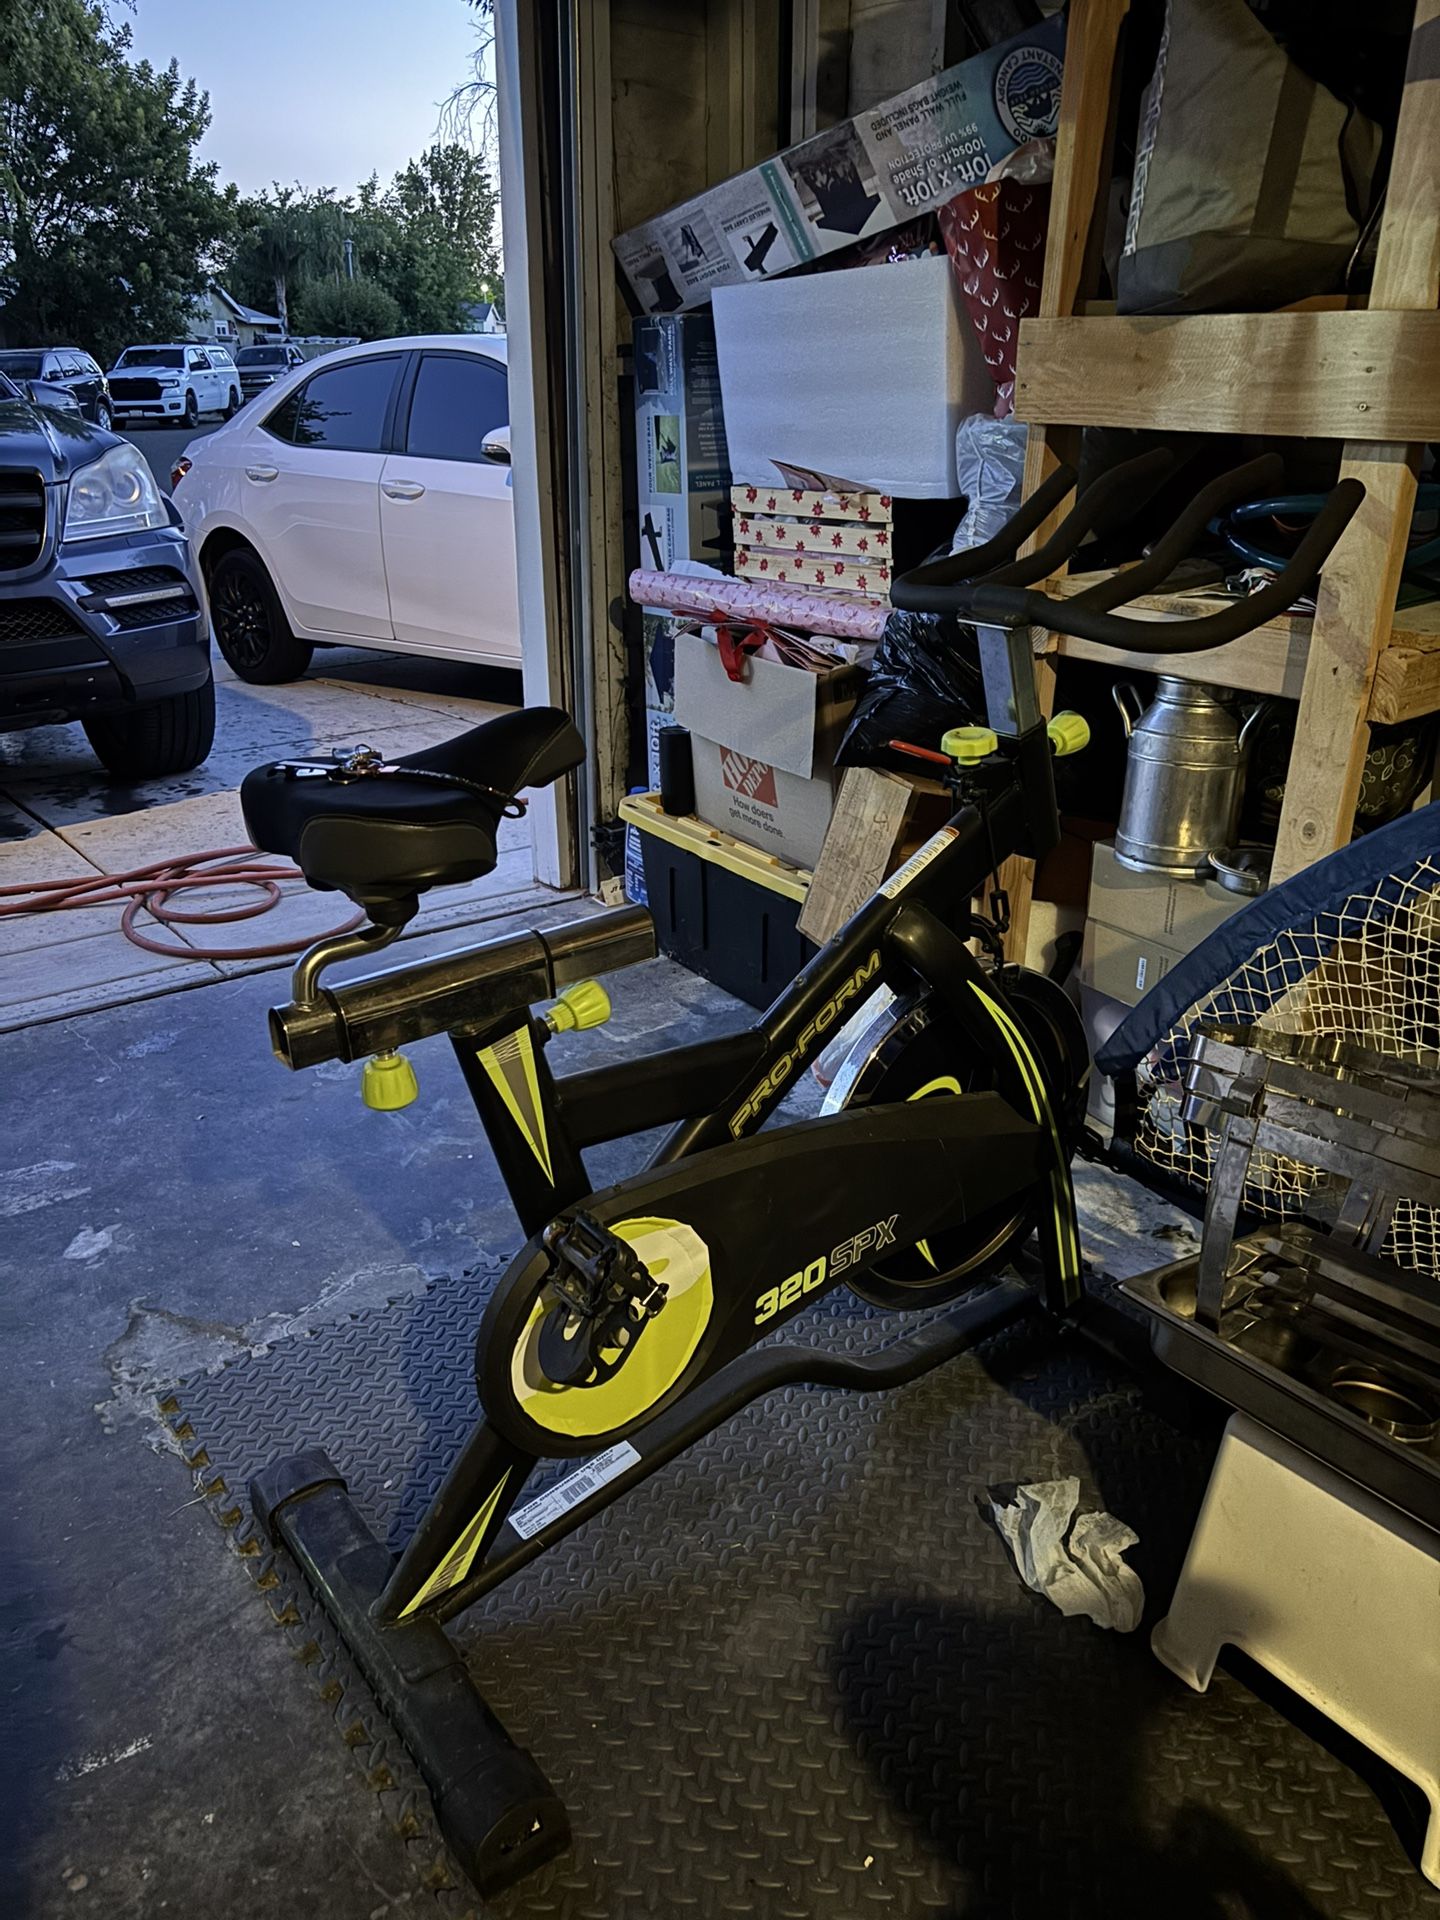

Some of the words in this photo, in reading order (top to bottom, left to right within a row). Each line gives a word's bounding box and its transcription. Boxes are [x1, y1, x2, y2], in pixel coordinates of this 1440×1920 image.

[1019, 49, 1064, 74] NSTANT
[929, 80, 962, 100] WEIGHT
[996, 55, 1018, 104] CANOPY
[907, 95, 929, 112] BAGS
[919, 102, 943, 117] WALL
[944, 91, 966, 106] FULL
[869, 106, 907, 130] INCLUDED
[892, 114, 918, 132] PANEL
[957, 122, 978, 137] 99%
[874, 127, 892, 140] AND
[943, 132, 957, 144] UV
[887, 139, 941, 169] PROTECTION
[937, 136, 985, 164] 100sq.ft.
[892, 162, 924, 183] Shade
[923, 157, 936, 169] of
[951, 152, 993, 182] 10ft.
[896, 176, 937, 205] 10ft.
[936, 170, 950, 188] x
[732, 217, 748, 228] CARRY
[742, 762, 768, 797] DEPO
[732, 796, 750, 811] How
[751, 804, 775, 821] doers
[728, 806, 741, 819] get
[742, 815, 762, 829] more
[762, 822, 785, 838] done.
[729, 949, 882, 1140] PRO-FORM
[754, 1256, 828, 1325] 320
[829, 1214, 901, 1278] SPX
[522, 1501, 538, 1512] FOR
[538, 1472, 580, 1501] CONSUMER
